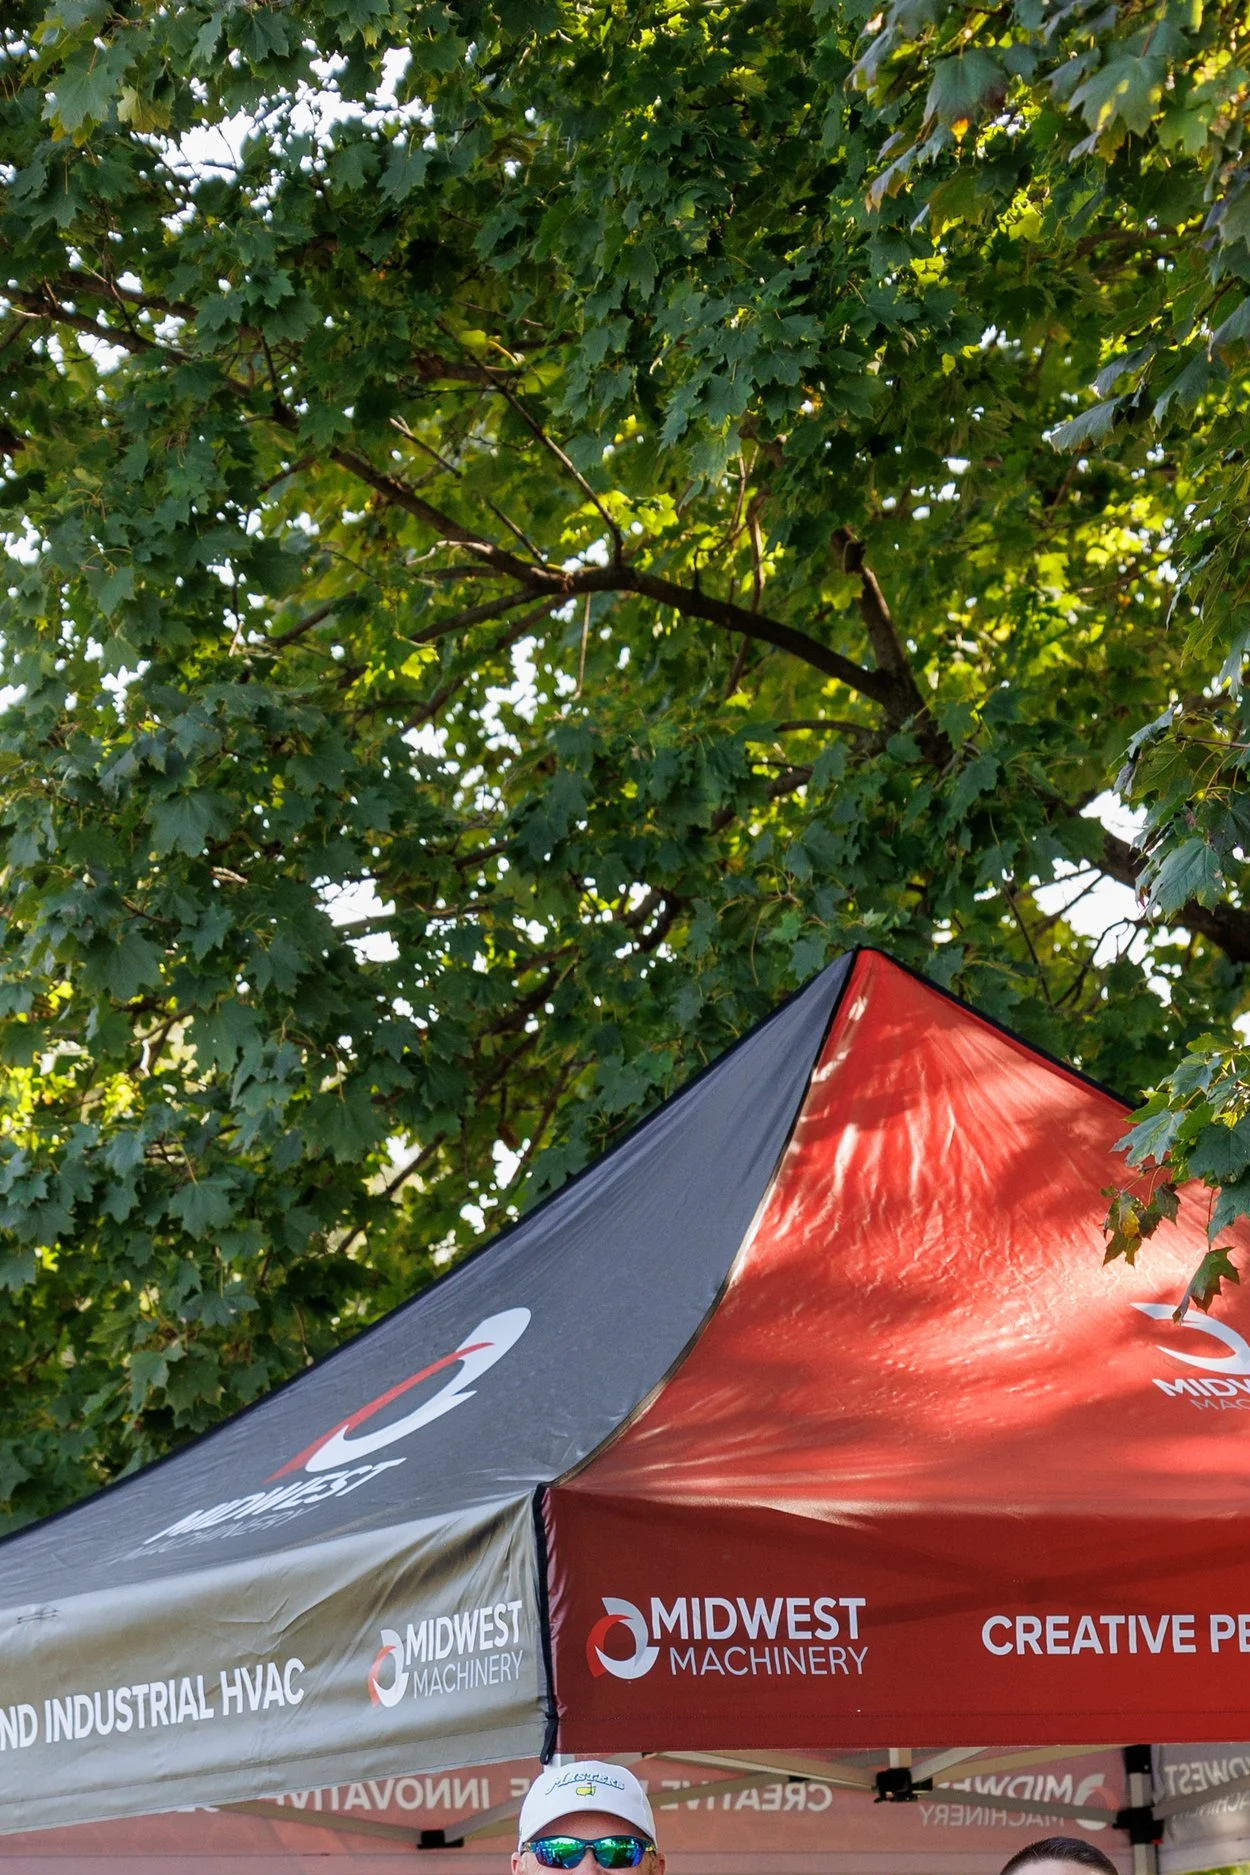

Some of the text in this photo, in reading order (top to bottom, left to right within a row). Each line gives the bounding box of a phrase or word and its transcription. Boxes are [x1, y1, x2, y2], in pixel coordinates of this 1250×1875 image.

[144, 1458, 407, 1545] MIDWEST
[405, 1600, 523, 1663] MIDWEST
[651, 1597, 867, 1641] MIDWEST
[982, 1614, 1197, 1656] CREATIVE
[412, 1649, 524, 1699] MACHINERY
[669, 1647, 869, 1676] MACHINERY
[45, 1675, 214, 1744] INDUSTRIAL
[220, 1657, 305, 1716] HVAC
